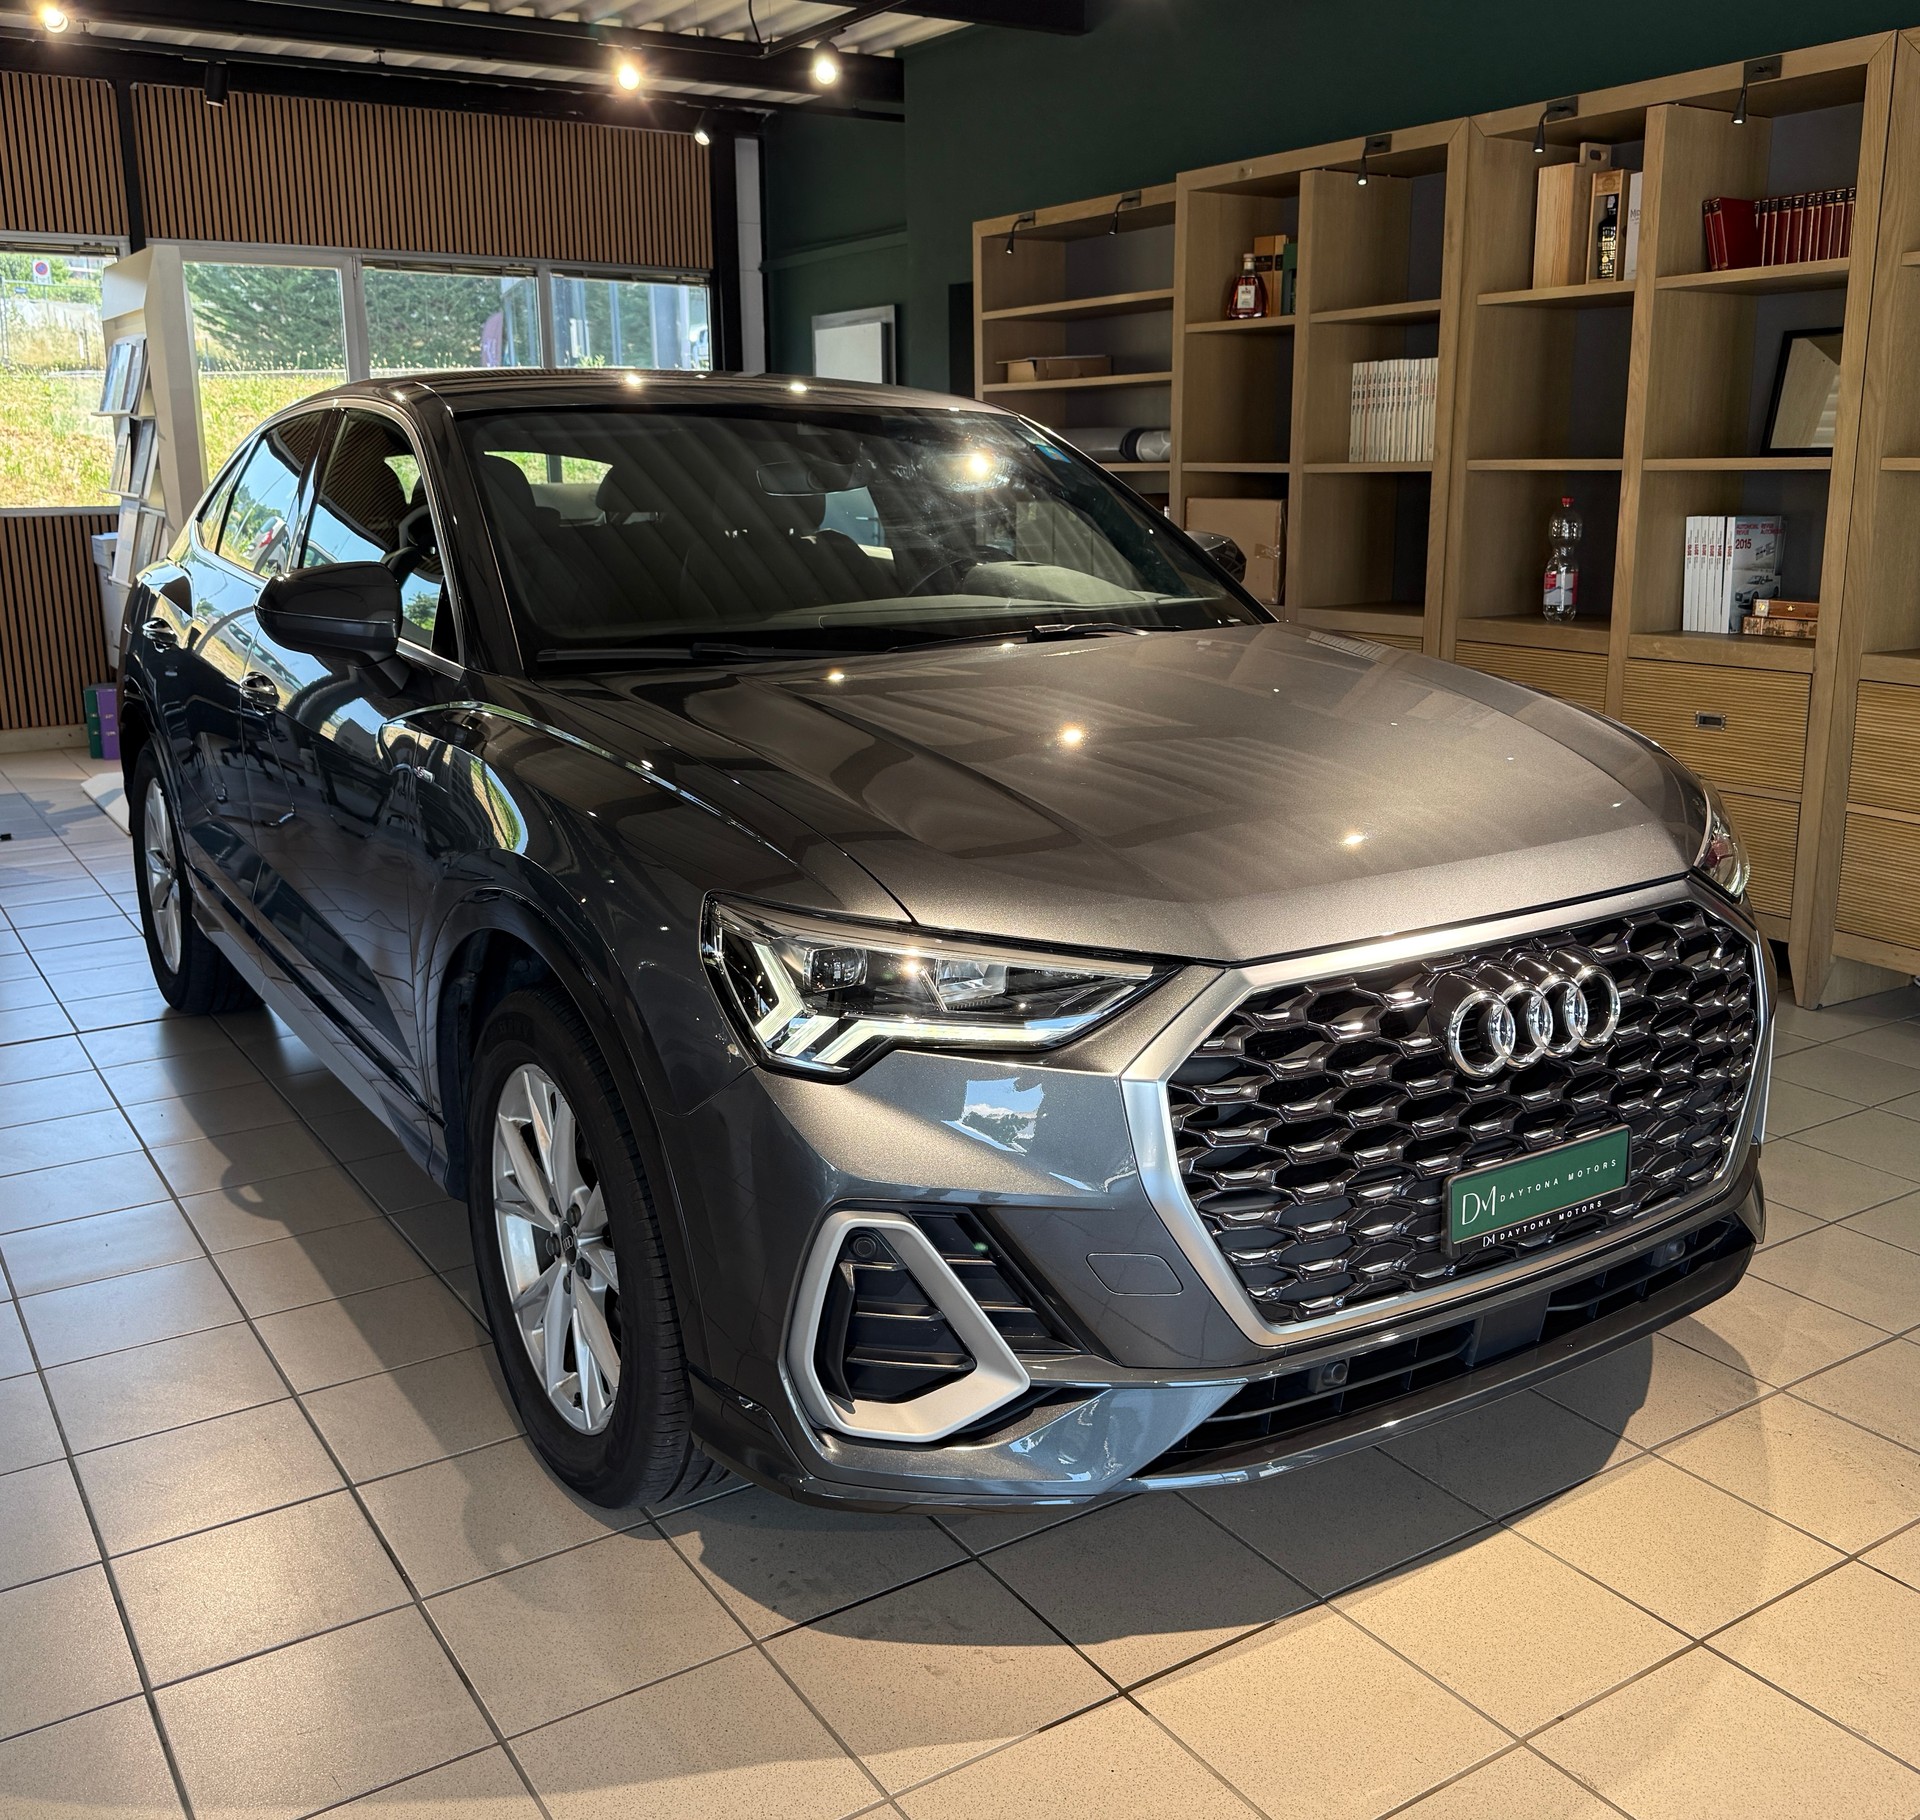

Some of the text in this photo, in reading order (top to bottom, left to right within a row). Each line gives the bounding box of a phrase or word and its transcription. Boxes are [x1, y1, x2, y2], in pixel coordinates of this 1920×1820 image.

[1735, 538, 1752, 550] 2015
[1500, 1177, 1559, 1203] DAYTONA
[1567, 1159, 1617, 1181] MOTORS
[1500, 1217, 1551, 1240] DAYTONA
[1558, 1200, 1602, 1221] MOTORS
